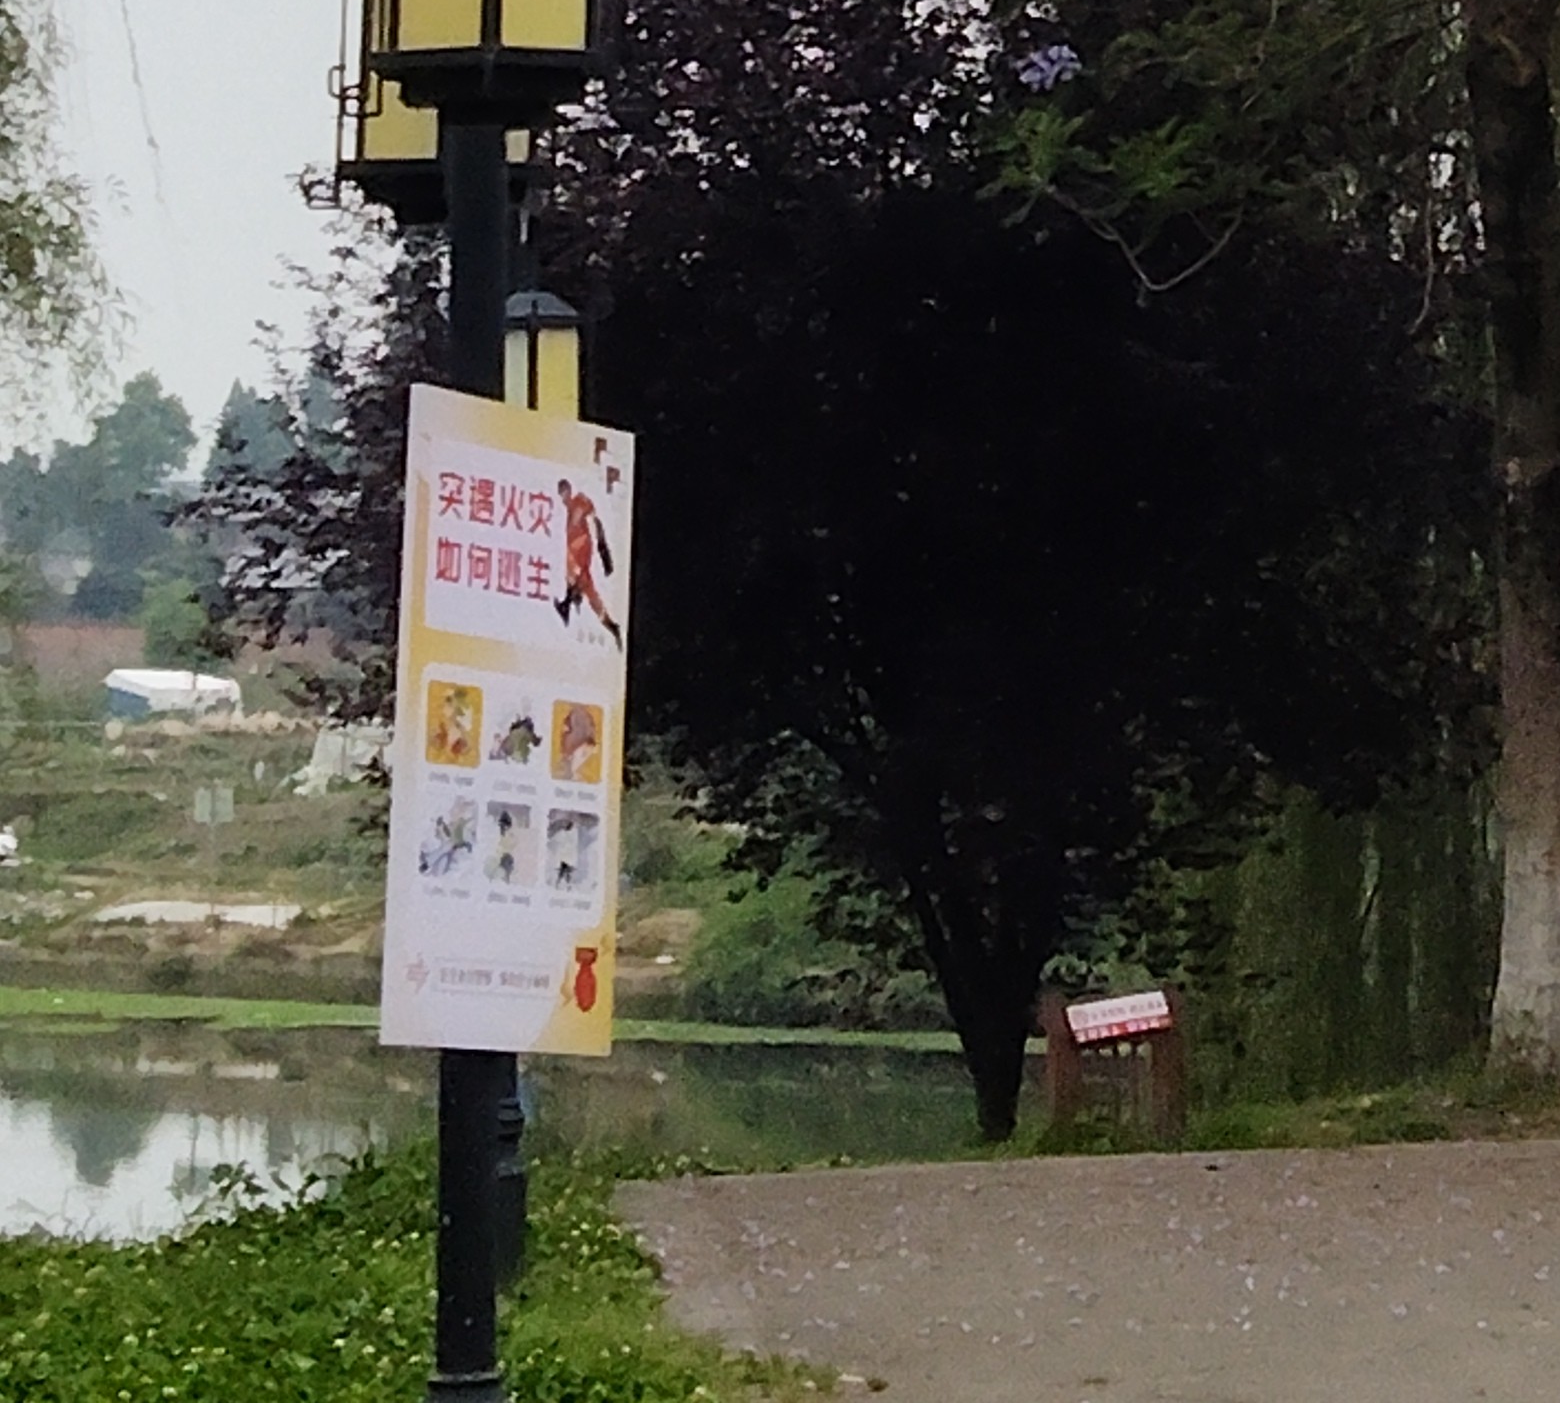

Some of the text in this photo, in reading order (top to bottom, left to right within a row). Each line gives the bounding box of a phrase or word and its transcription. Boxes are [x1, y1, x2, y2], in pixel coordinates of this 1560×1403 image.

[438, 471, 554, 537] 突遇火灾
[435, 536, 550, 601] 如何逃生
